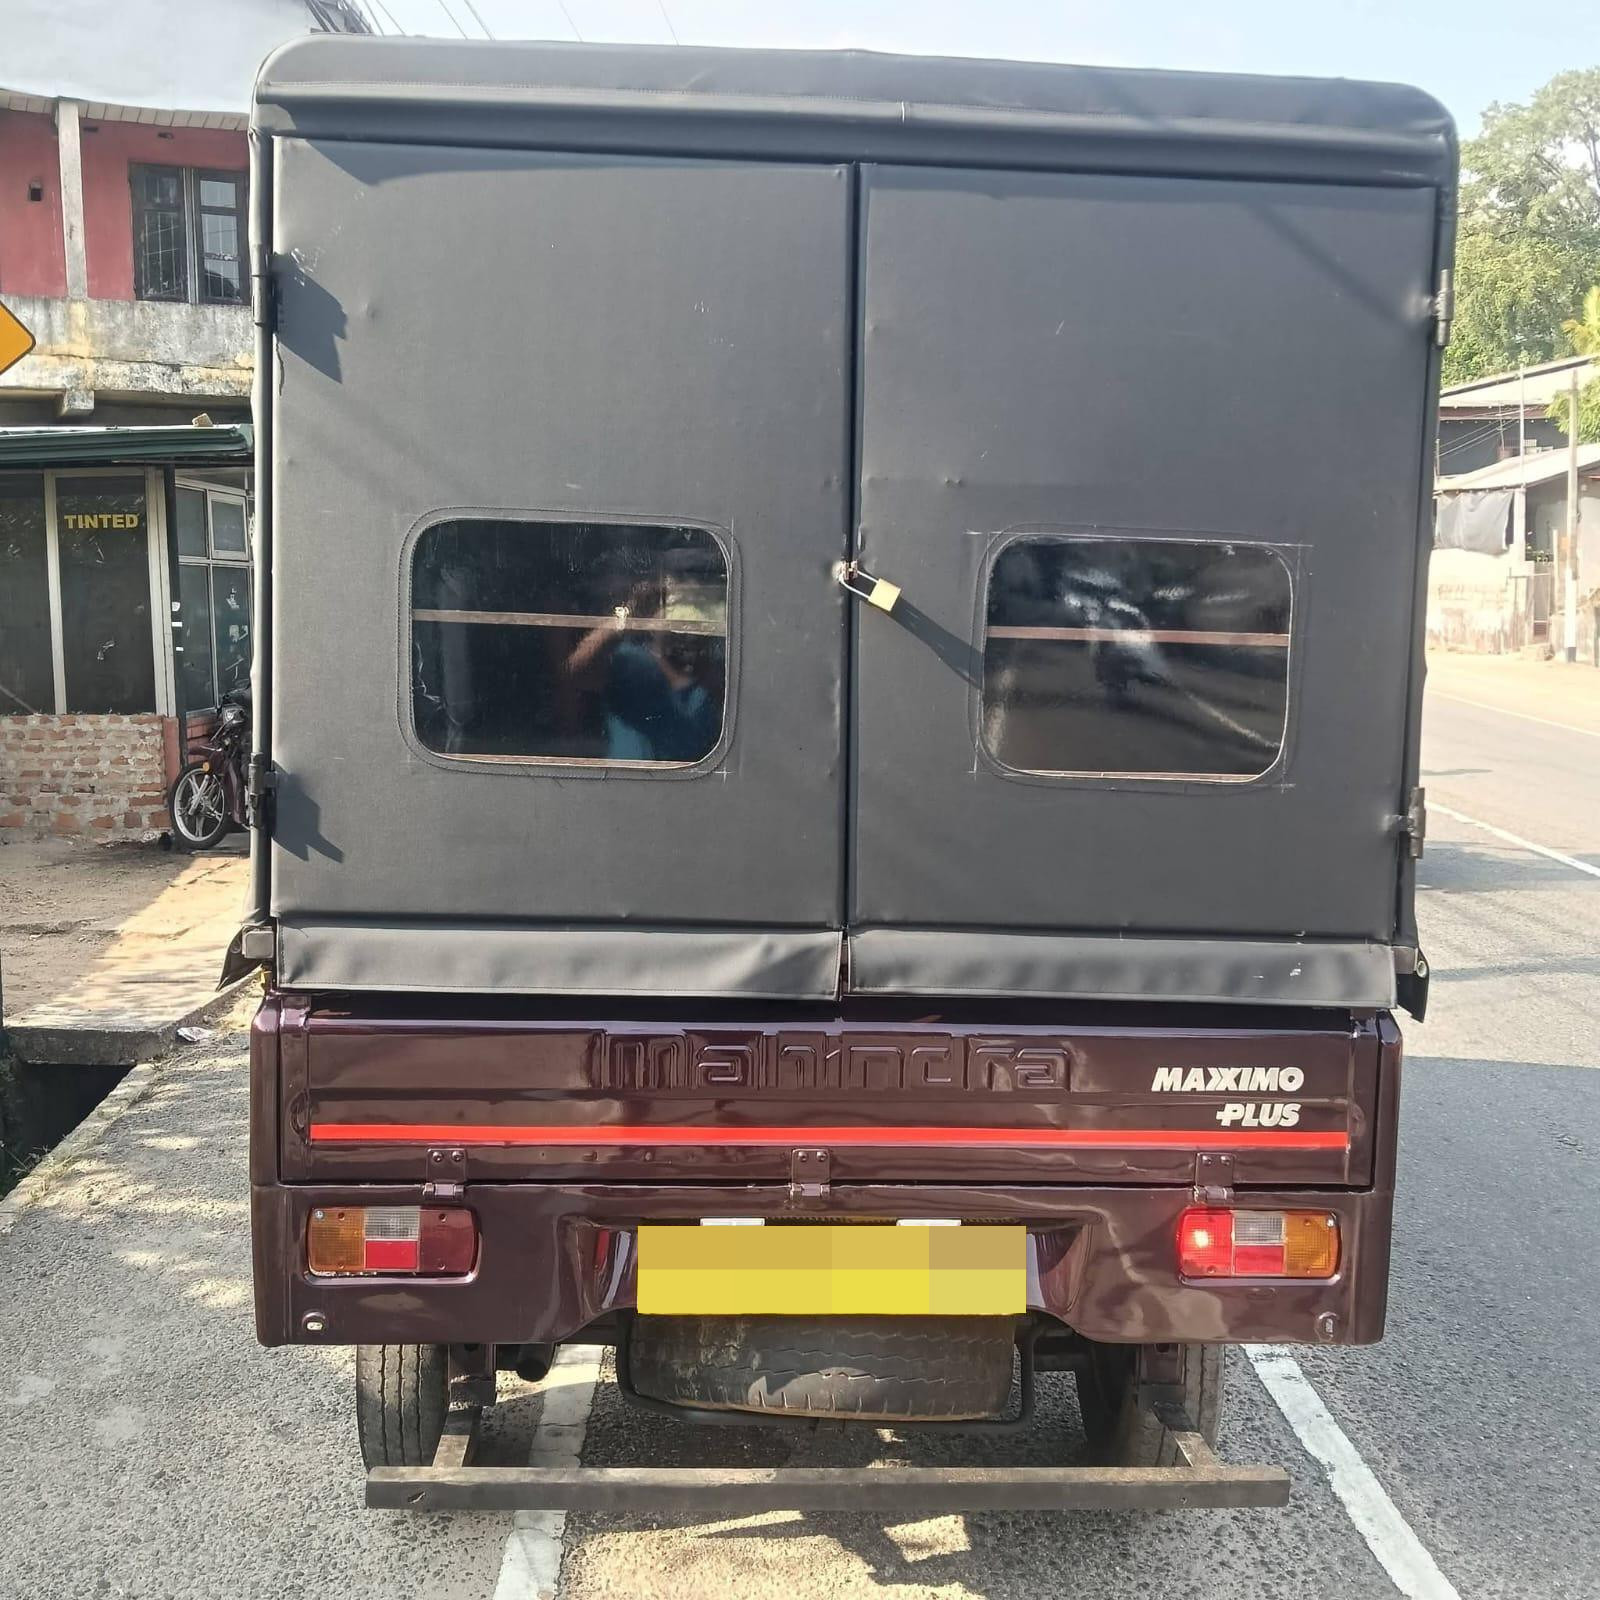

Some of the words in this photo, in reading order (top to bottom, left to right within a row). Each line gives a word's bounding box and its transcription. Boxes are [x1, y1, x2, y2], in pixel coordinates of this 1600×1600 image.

[64, 513, 139, 529] TINTED
[598, 1033, 1072, 1092] mahindra
[1151, 1066, 1305, 1092] MAXXIMO
